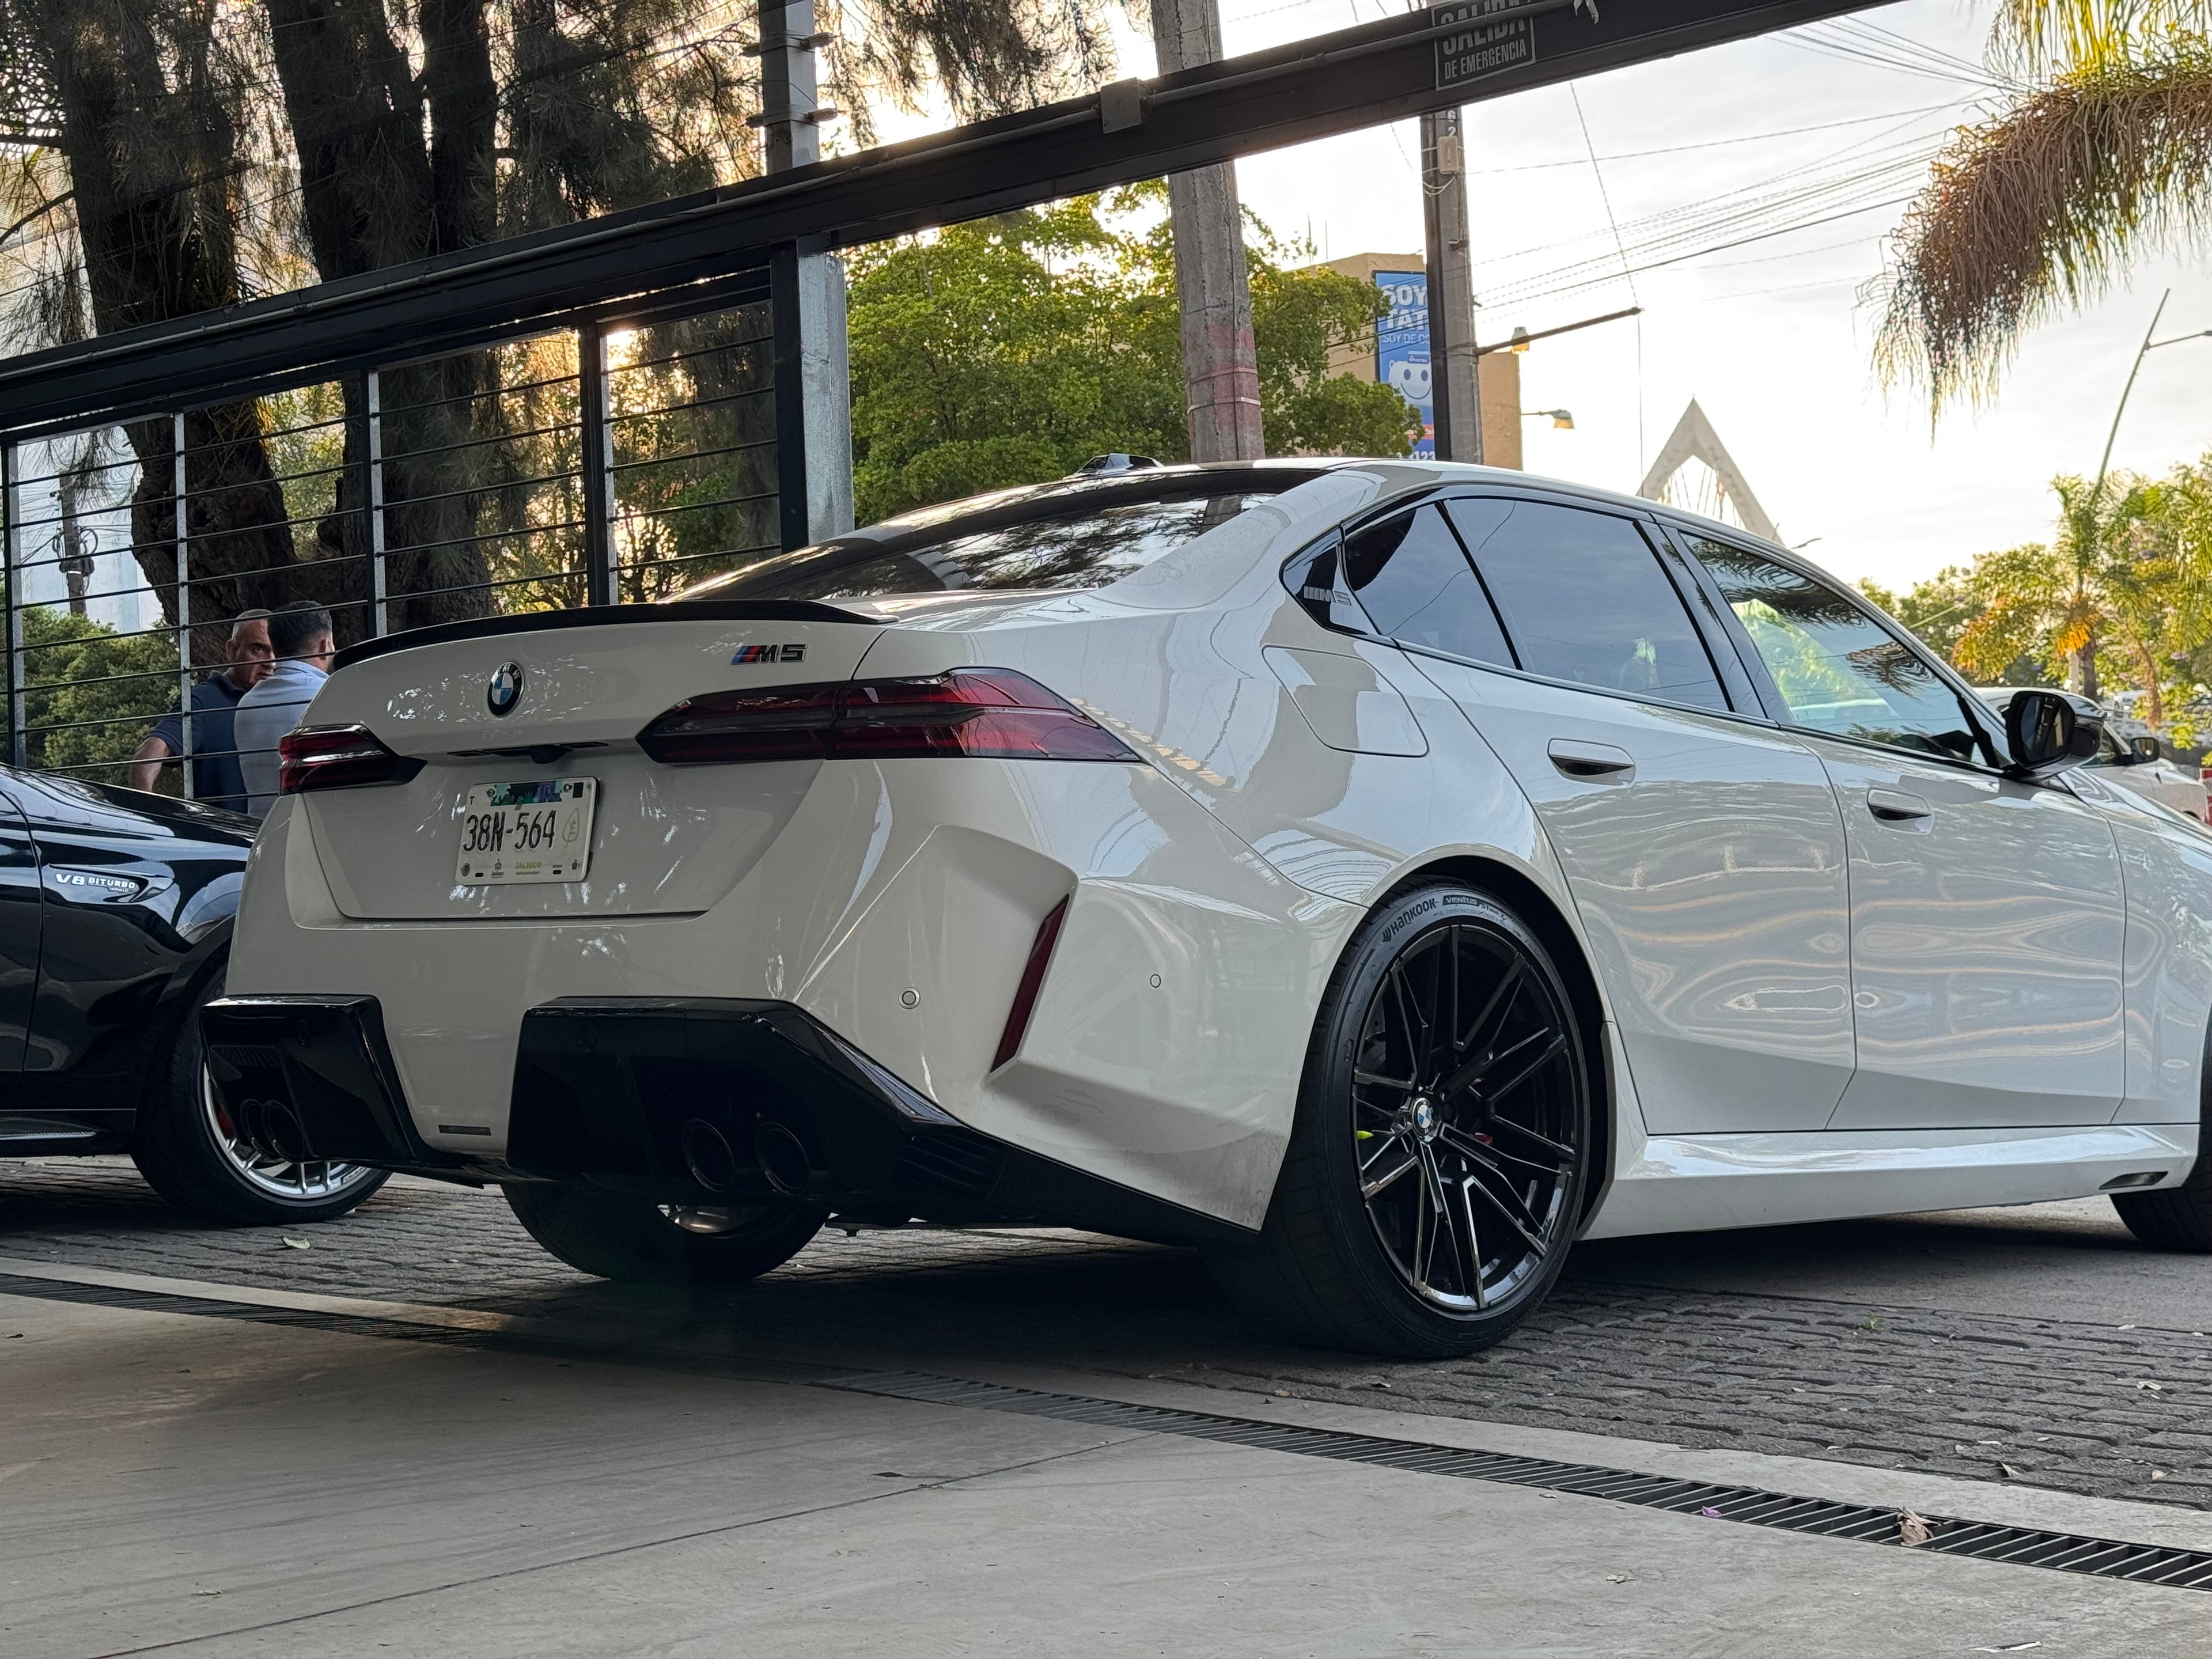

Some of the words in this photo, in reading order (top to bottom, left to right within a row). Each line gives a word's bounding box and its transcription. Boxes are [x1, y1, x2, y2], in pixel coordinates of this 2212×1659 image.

[1445, 59, 1457, 79] DE
[1461, 39, 1527, 75] EMERGENCIA
[1381, 284, 1427, 306] SOY
[1383, 334, 1401, 343] SOY
[1404, 334, 1416, 344] DE
[749, 644, 808, 664] M5
[463, 809, 557, 852] 38N-564
[515, 861, 542, 869] JALISCO
[56, 873, 85, 885] V8
[88, 877, 135, 888] BITURBO
